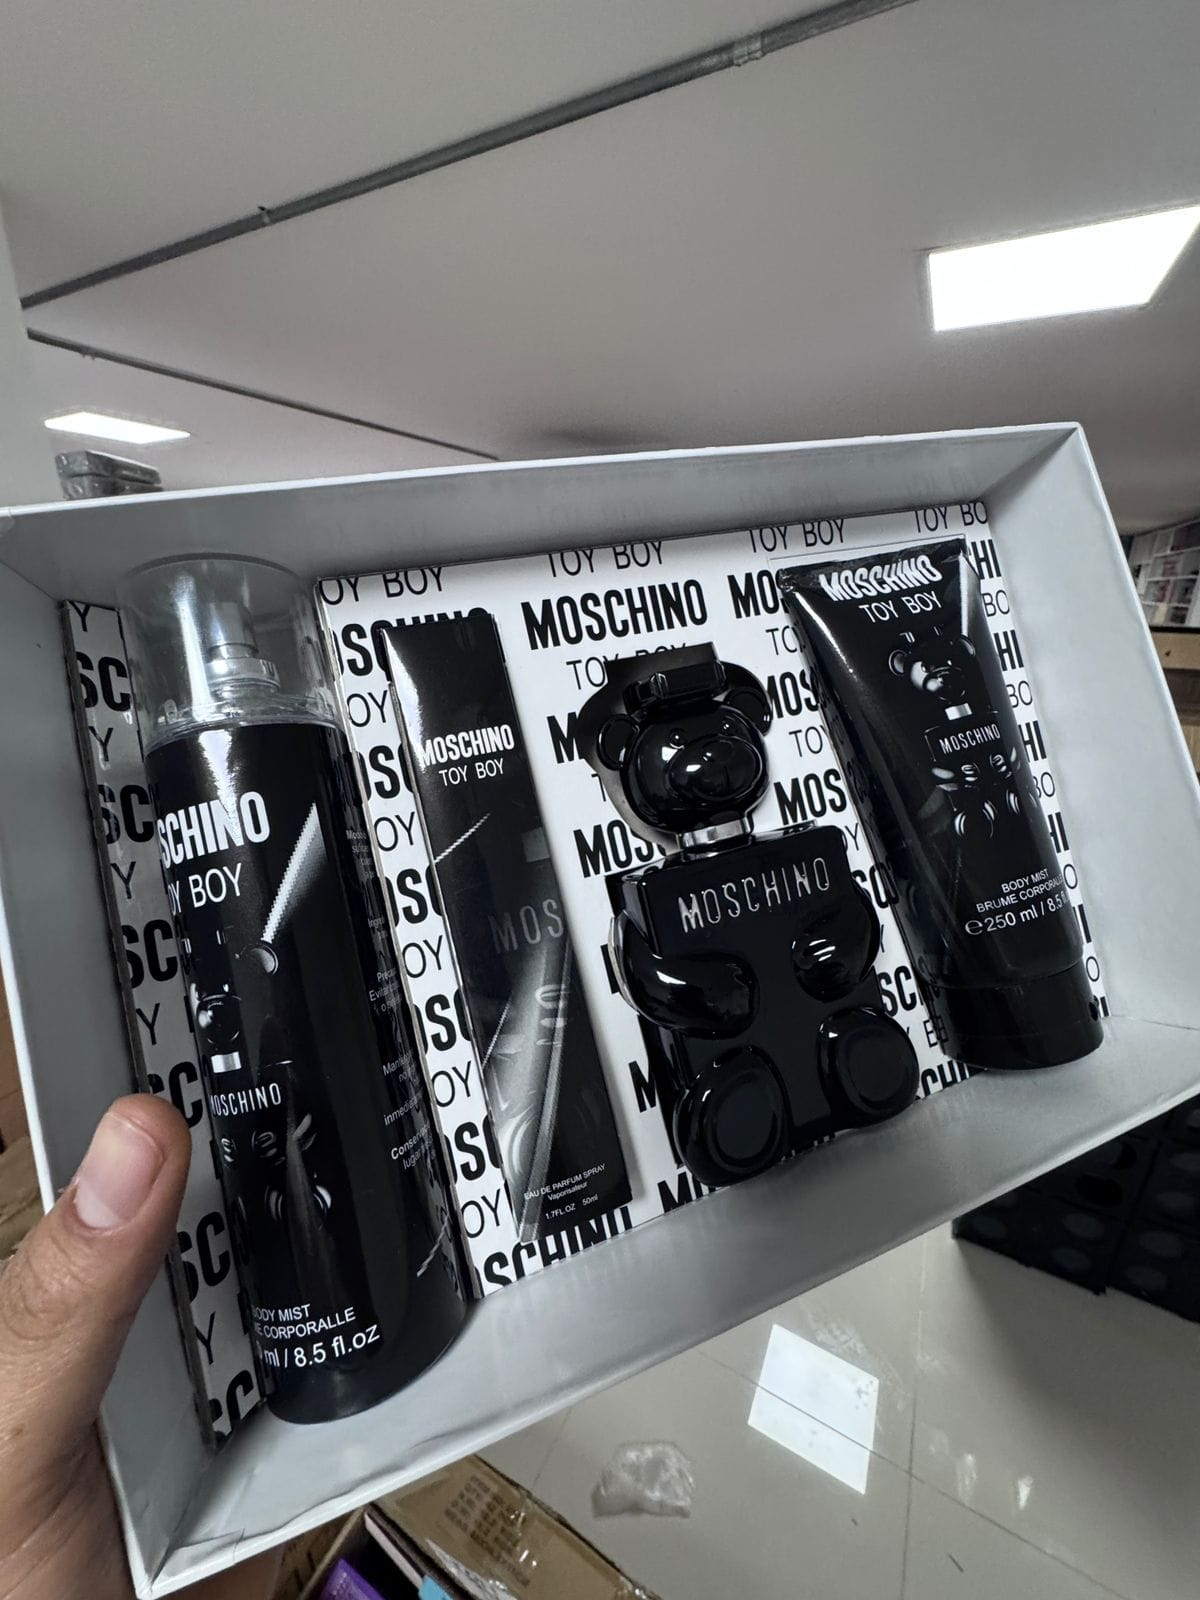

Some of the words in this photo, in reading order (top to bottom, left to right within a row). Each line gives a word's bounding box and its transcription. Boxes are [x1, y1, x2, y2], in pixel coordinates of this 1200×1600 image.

[803, 518, 845, 547] BOY
[612, 540, 665, 569] BOY
[382, 567, 443, 598] BOY
[818, 554, 943, 602] MOSCHINO
[520, 579, 709, 651] MOSCHINO
[859, 601, 898, 625] TOY
[901, 590, 942, 616] BOY
[418, 724, 515, 768] MOSCHINO
[939, 722, 1001, 754] MOSCHINO
[438, 765, 467, 786] TOY
[475, 758, 503, 779] BOY
[188, 862, 242, 908] BOY
[678, 857, 830, 934] MOSCHINO
[1001, 876, 1030, 894] BODY
[1031, 868, 1049, 883] MIST
[976, 894, 1019, 913] BRUME
[1020, 904, 1038, 922] ml
[524, 1190, 539, 1200] EAU
[541, 1186, 552, 1195] DE
[552, 1174, 582, 1190] PARFUM
[583, 1163, 606, 1179] SPRAY
[583, 1194, 598, 1206] 50ml
[254, 1307, 275, 1322] ODY
[278, 1304, 310, 1321] MIST
[263, 1306, 356, 1339] CORPORALLE
[294, 1342, 326, 1367] 8.5
